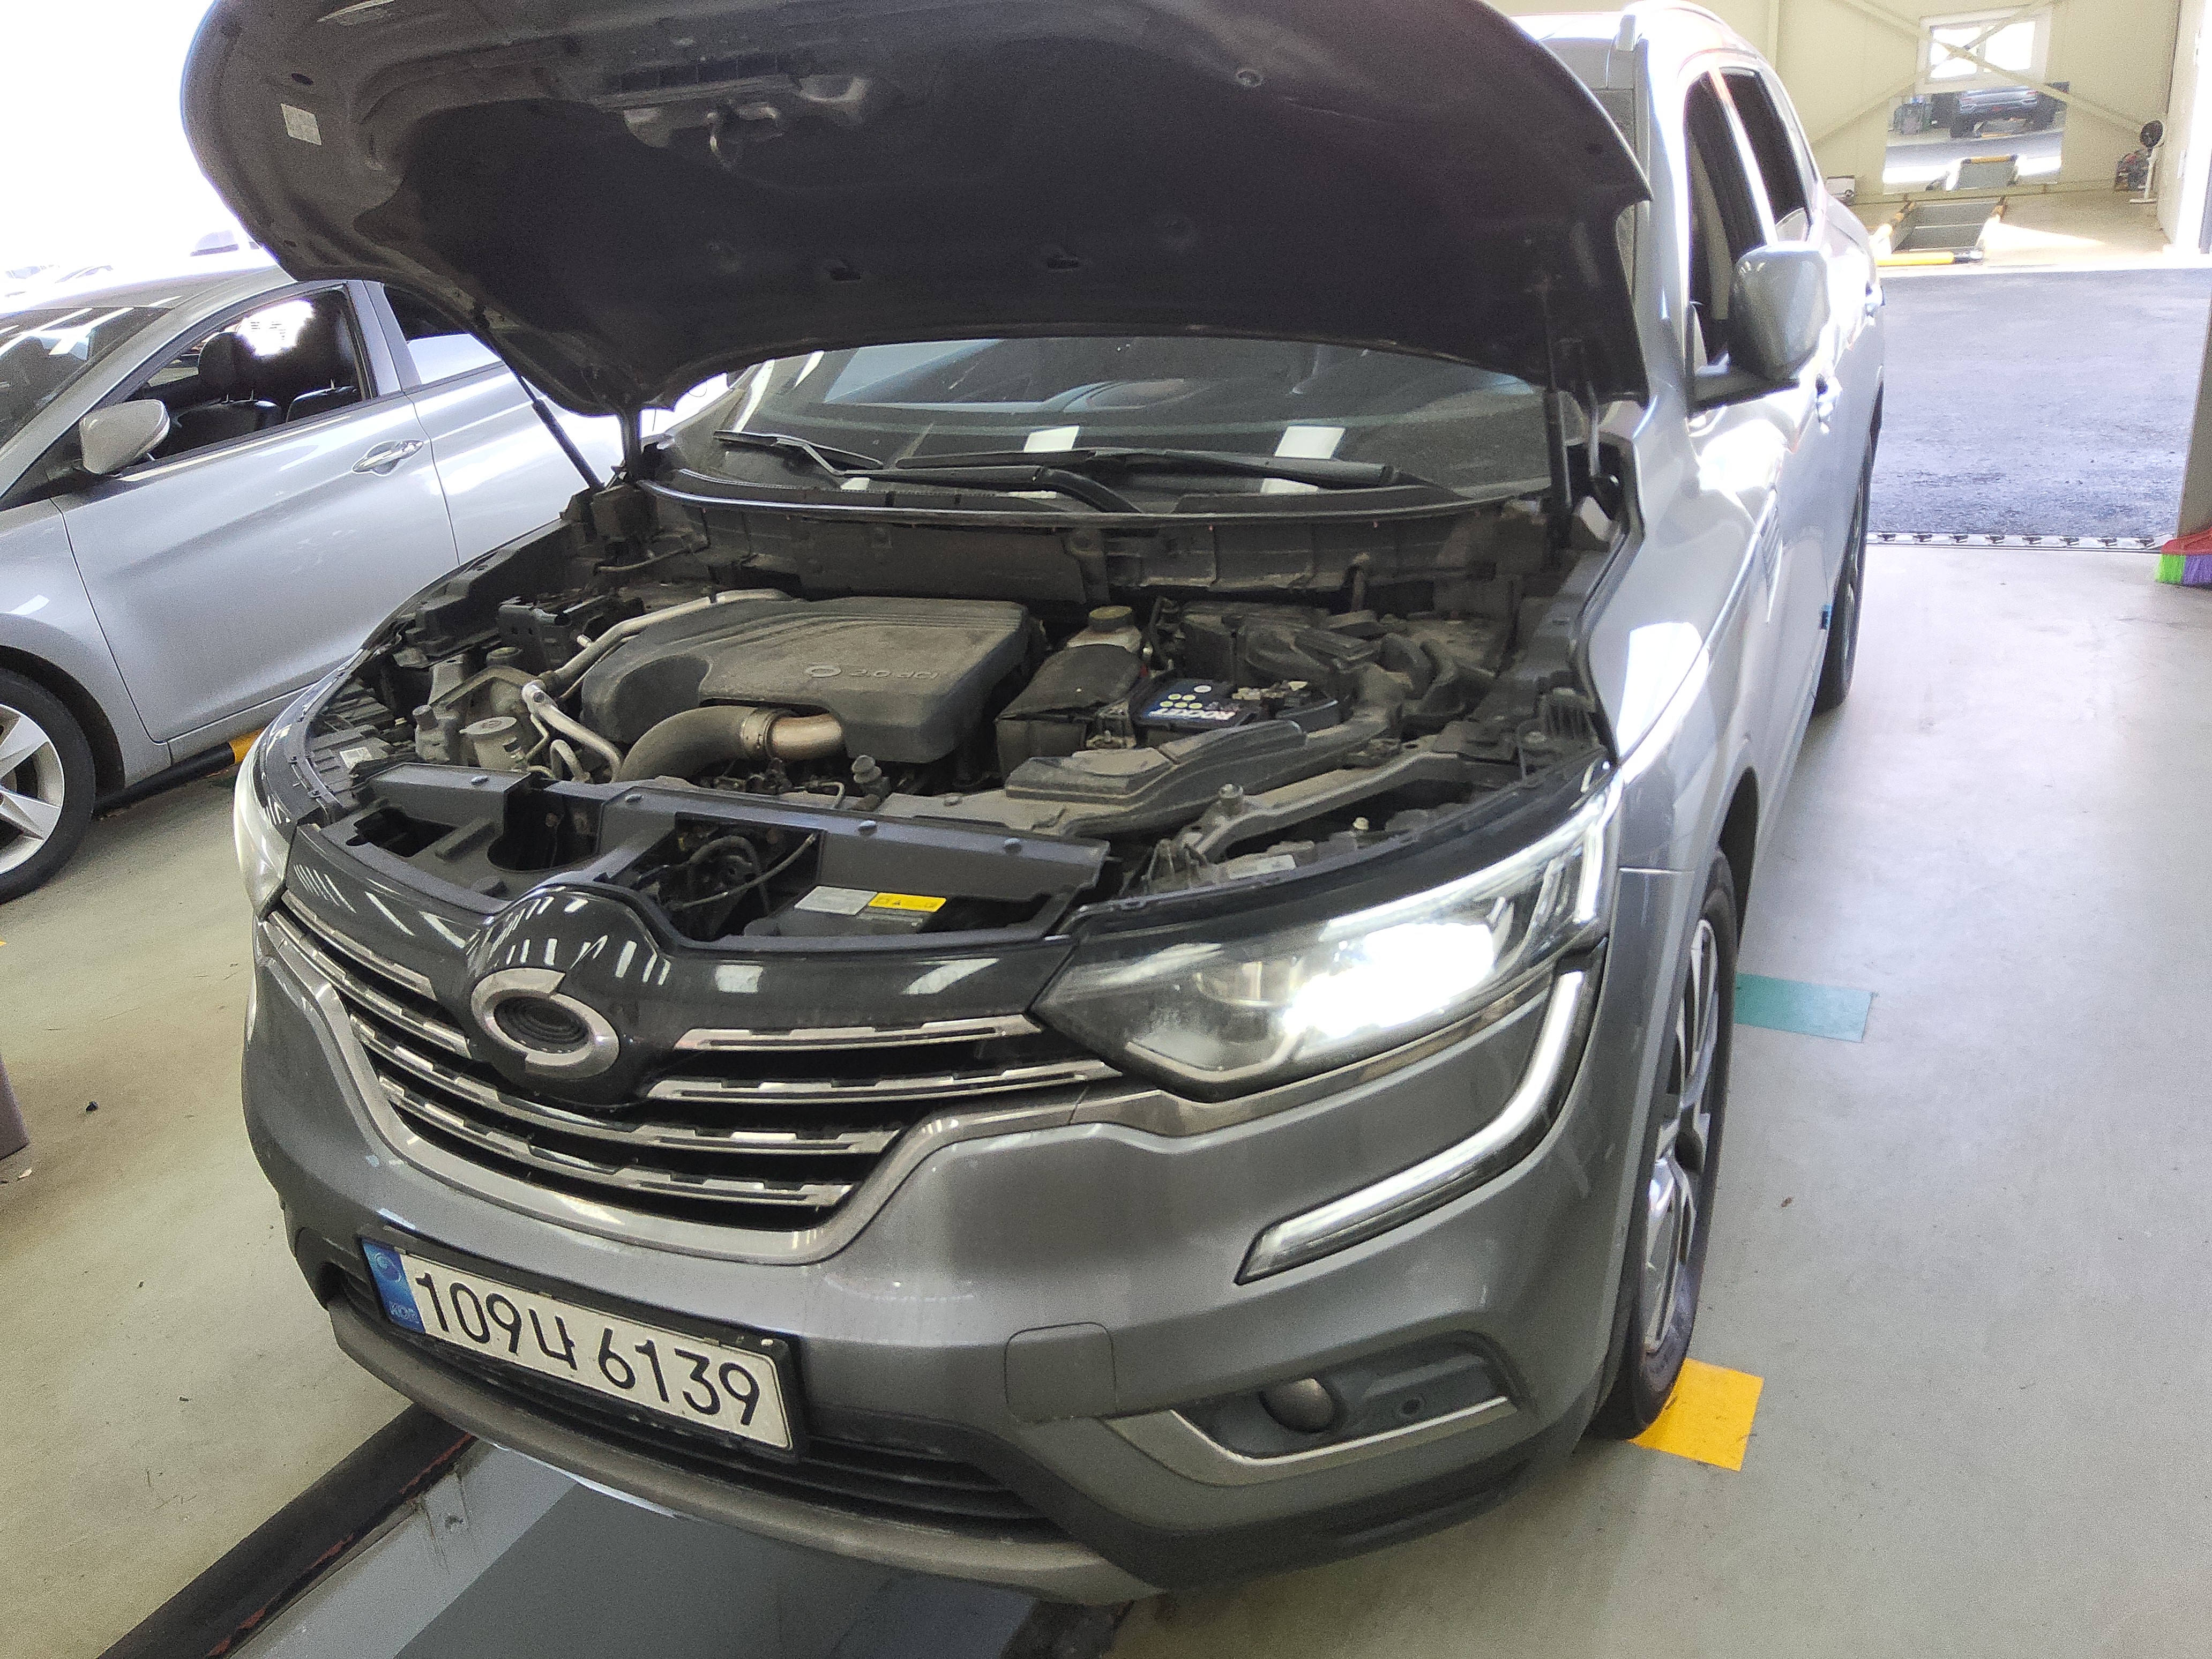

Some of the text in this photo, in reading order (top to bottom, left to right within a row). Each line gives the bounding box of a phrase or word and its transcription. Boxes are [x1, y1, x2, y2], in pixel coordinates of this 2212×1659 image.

[389, 1301, 420, 1324] KOR
[416, 1272, 760, 1426] 109나 6139
